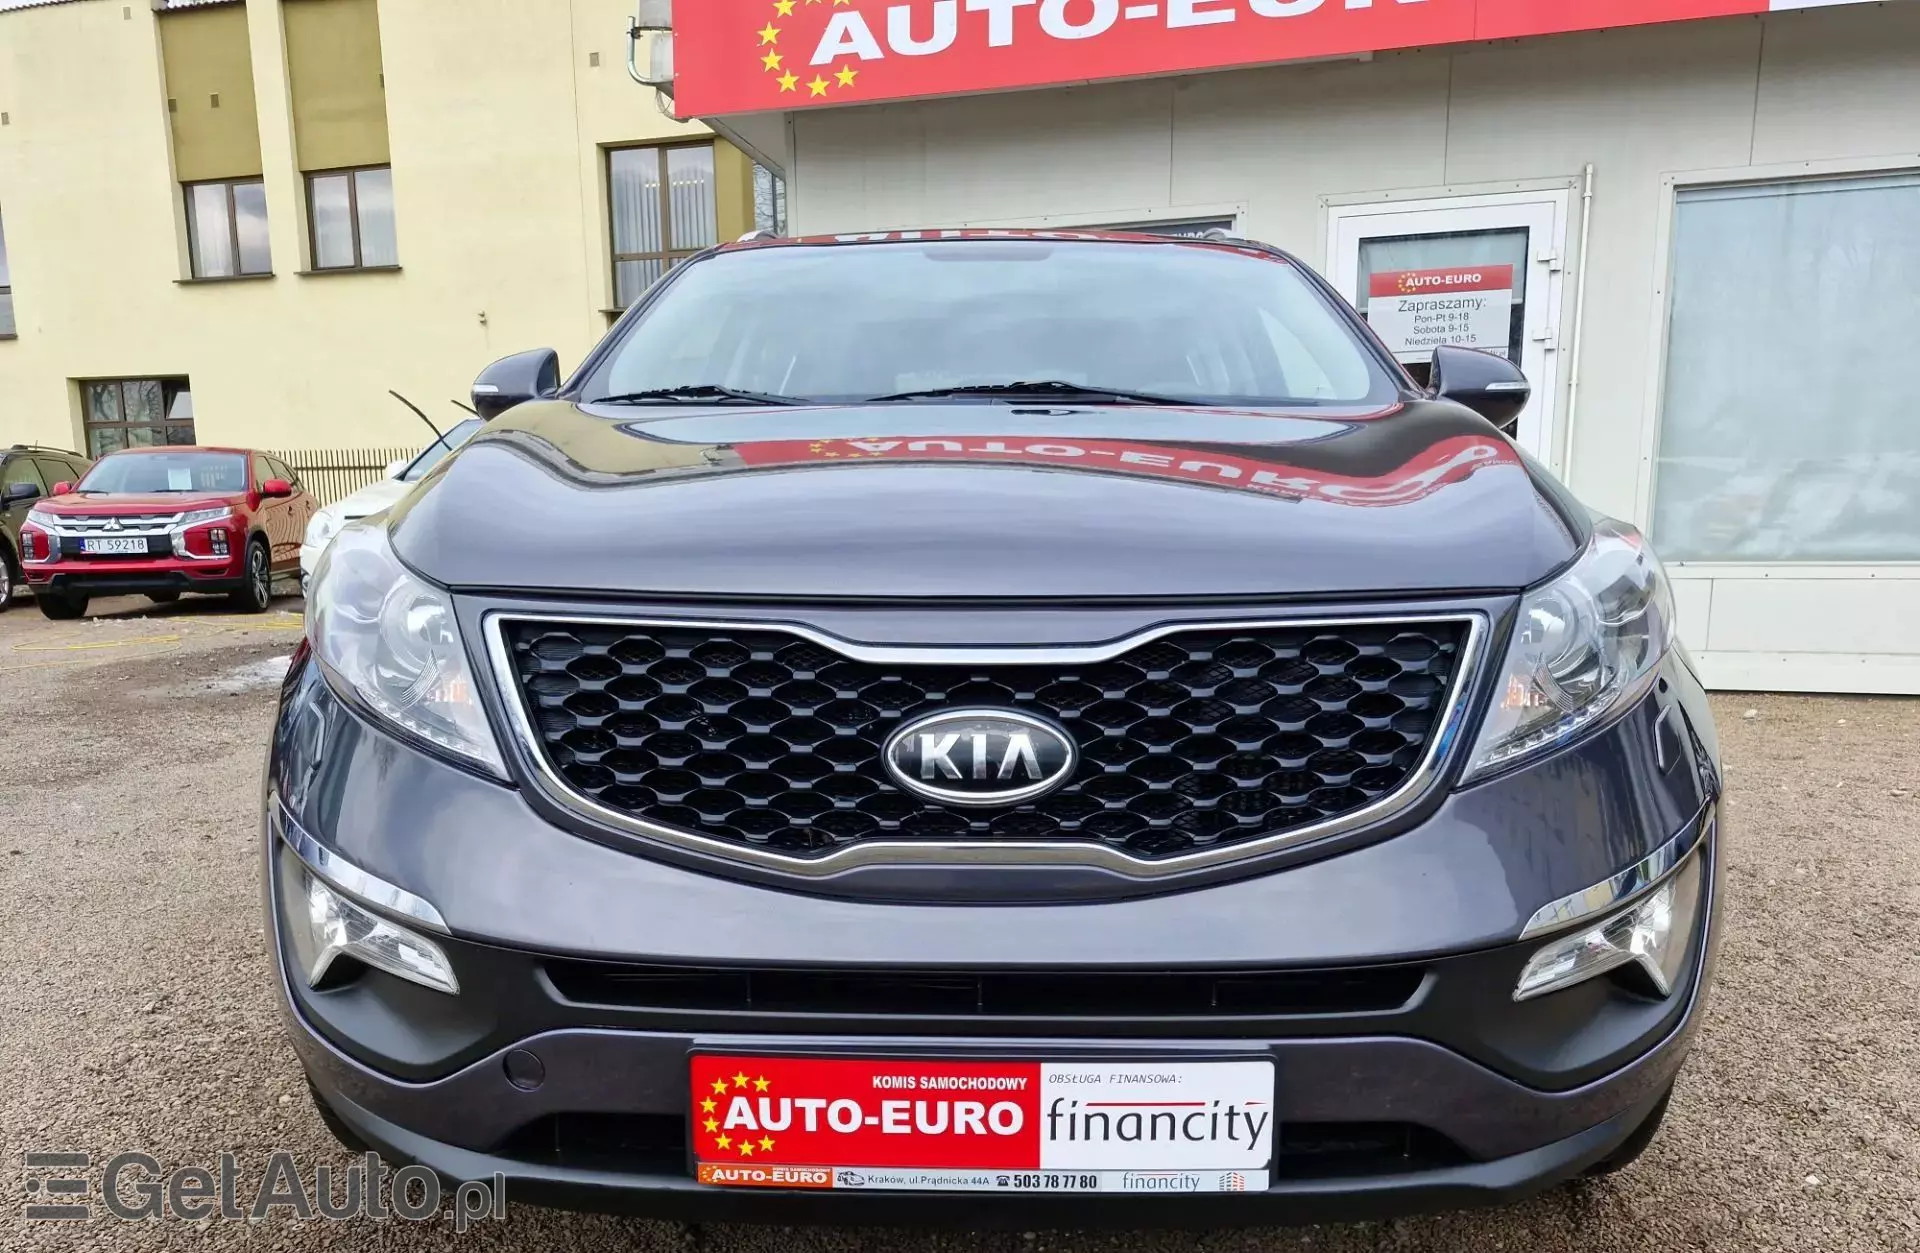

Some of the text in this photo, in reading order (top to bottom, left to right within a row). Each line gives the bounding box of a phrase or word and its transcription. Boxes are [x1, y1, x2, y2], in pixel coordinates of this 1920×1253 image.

[1406, 273, 1482, 287] AUTO-EURO
[1398, 297, 1487, 313] Zapraszamy:
[1414, 312, 1469, 324] Pon-Pt 9-18
[1413, 323, 1469, 335] Sobota 9-15
[1405, 334, 1477, 346] Niedziela 10-15
[87, 539, 145, 550] RT 59218
[919, 733, 1043, 780] KIA
[872, 1075, 1028, 1090] KOMIS SAMOCHODOWY
[1048, 1074, 1183, 1084] OBSŁUGA FINANSOWA:
[723, 1096, 1025, 1135] AUTO-EURO
[1047, 1097, 1269, 1151] financity
[711, 1168, 828, 1184] AUTO-EURO
[868, 1175, 906, 1185] Kraków,
[971, 1177, 990, 1186] 44A
[1013, 1174, 1097, 1189] 503 78 77 80
[1122, 1171, 1200, 1192] financity
